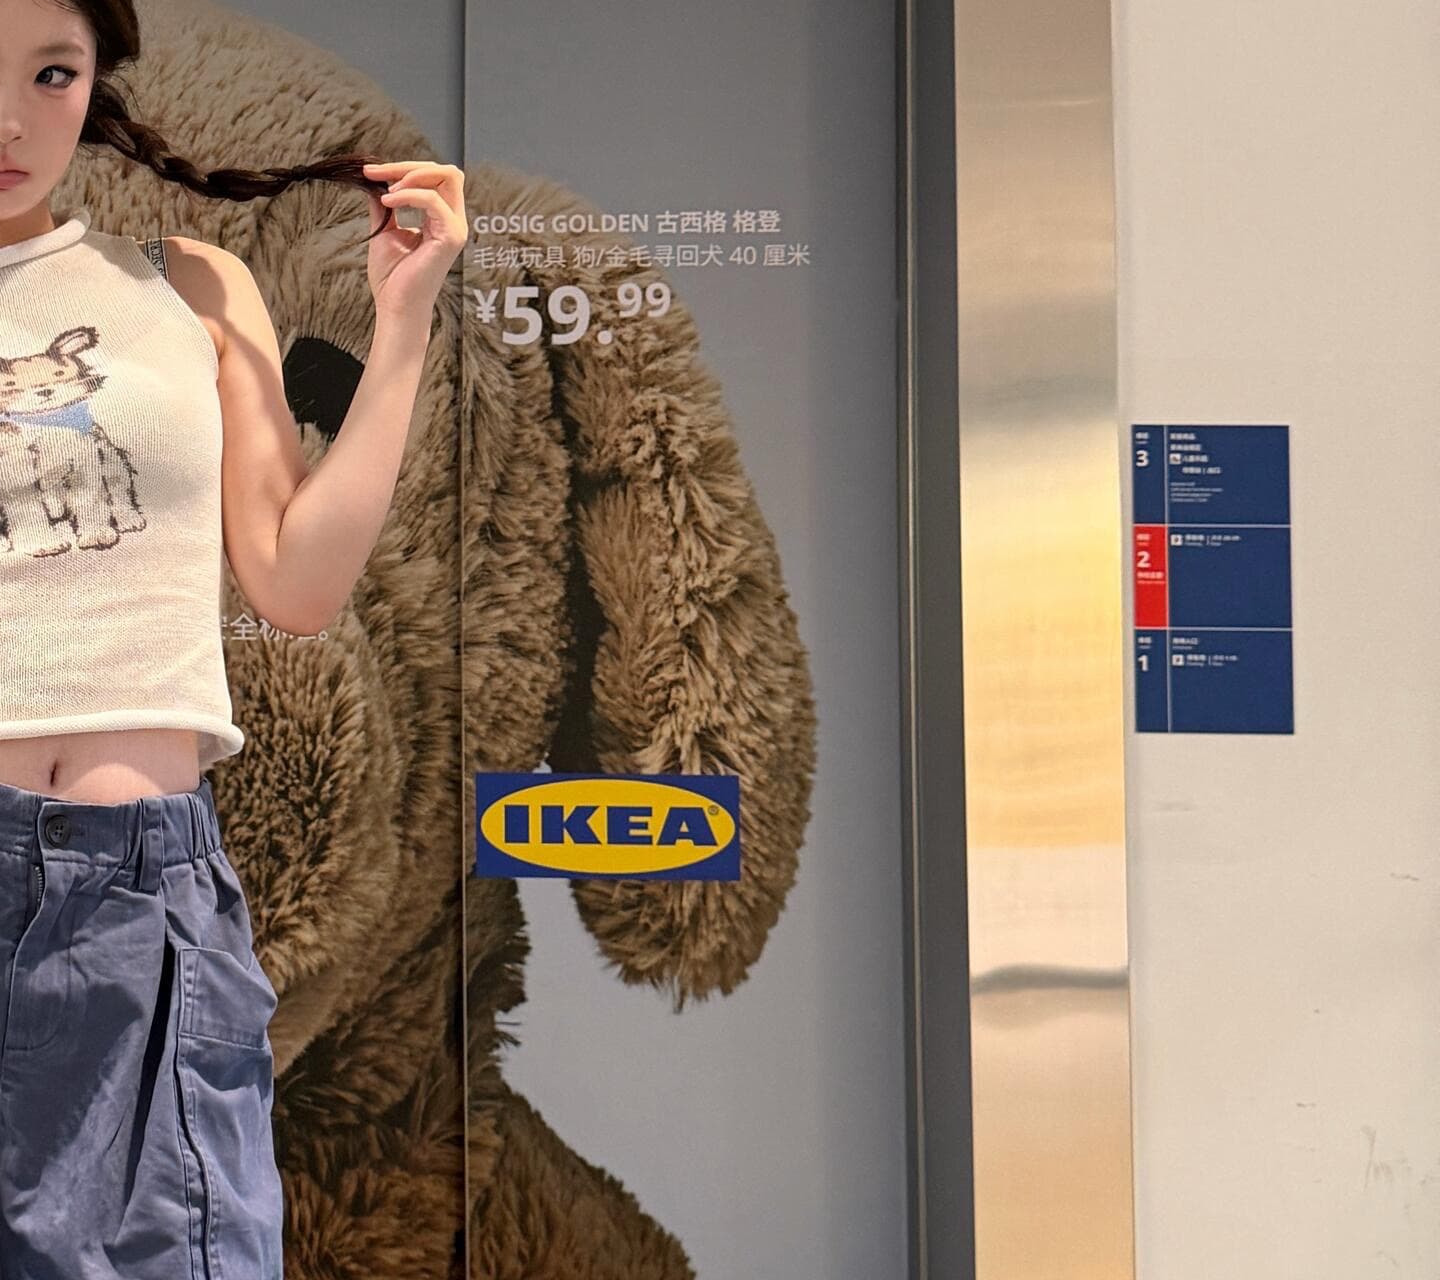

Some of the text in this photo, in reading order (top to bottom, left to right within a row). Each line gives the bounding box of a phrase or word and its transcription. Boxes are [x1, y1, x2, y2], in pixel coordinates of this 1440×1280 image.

[473, 208, 782, 235] GOSIG GOLDEN 古西格 格登
[473, 244, 812, 269] 毛绒玩具 狗/金毛寻回犬 40 厘米
[473, 282, 672, 346] ¥59.99
[1136, 450, 1149, 467] 3
[1137, 551, 1151, 568] 2
[1137, 655, 1149, 672] 1
[503, 804, 719, 846] IKEA
